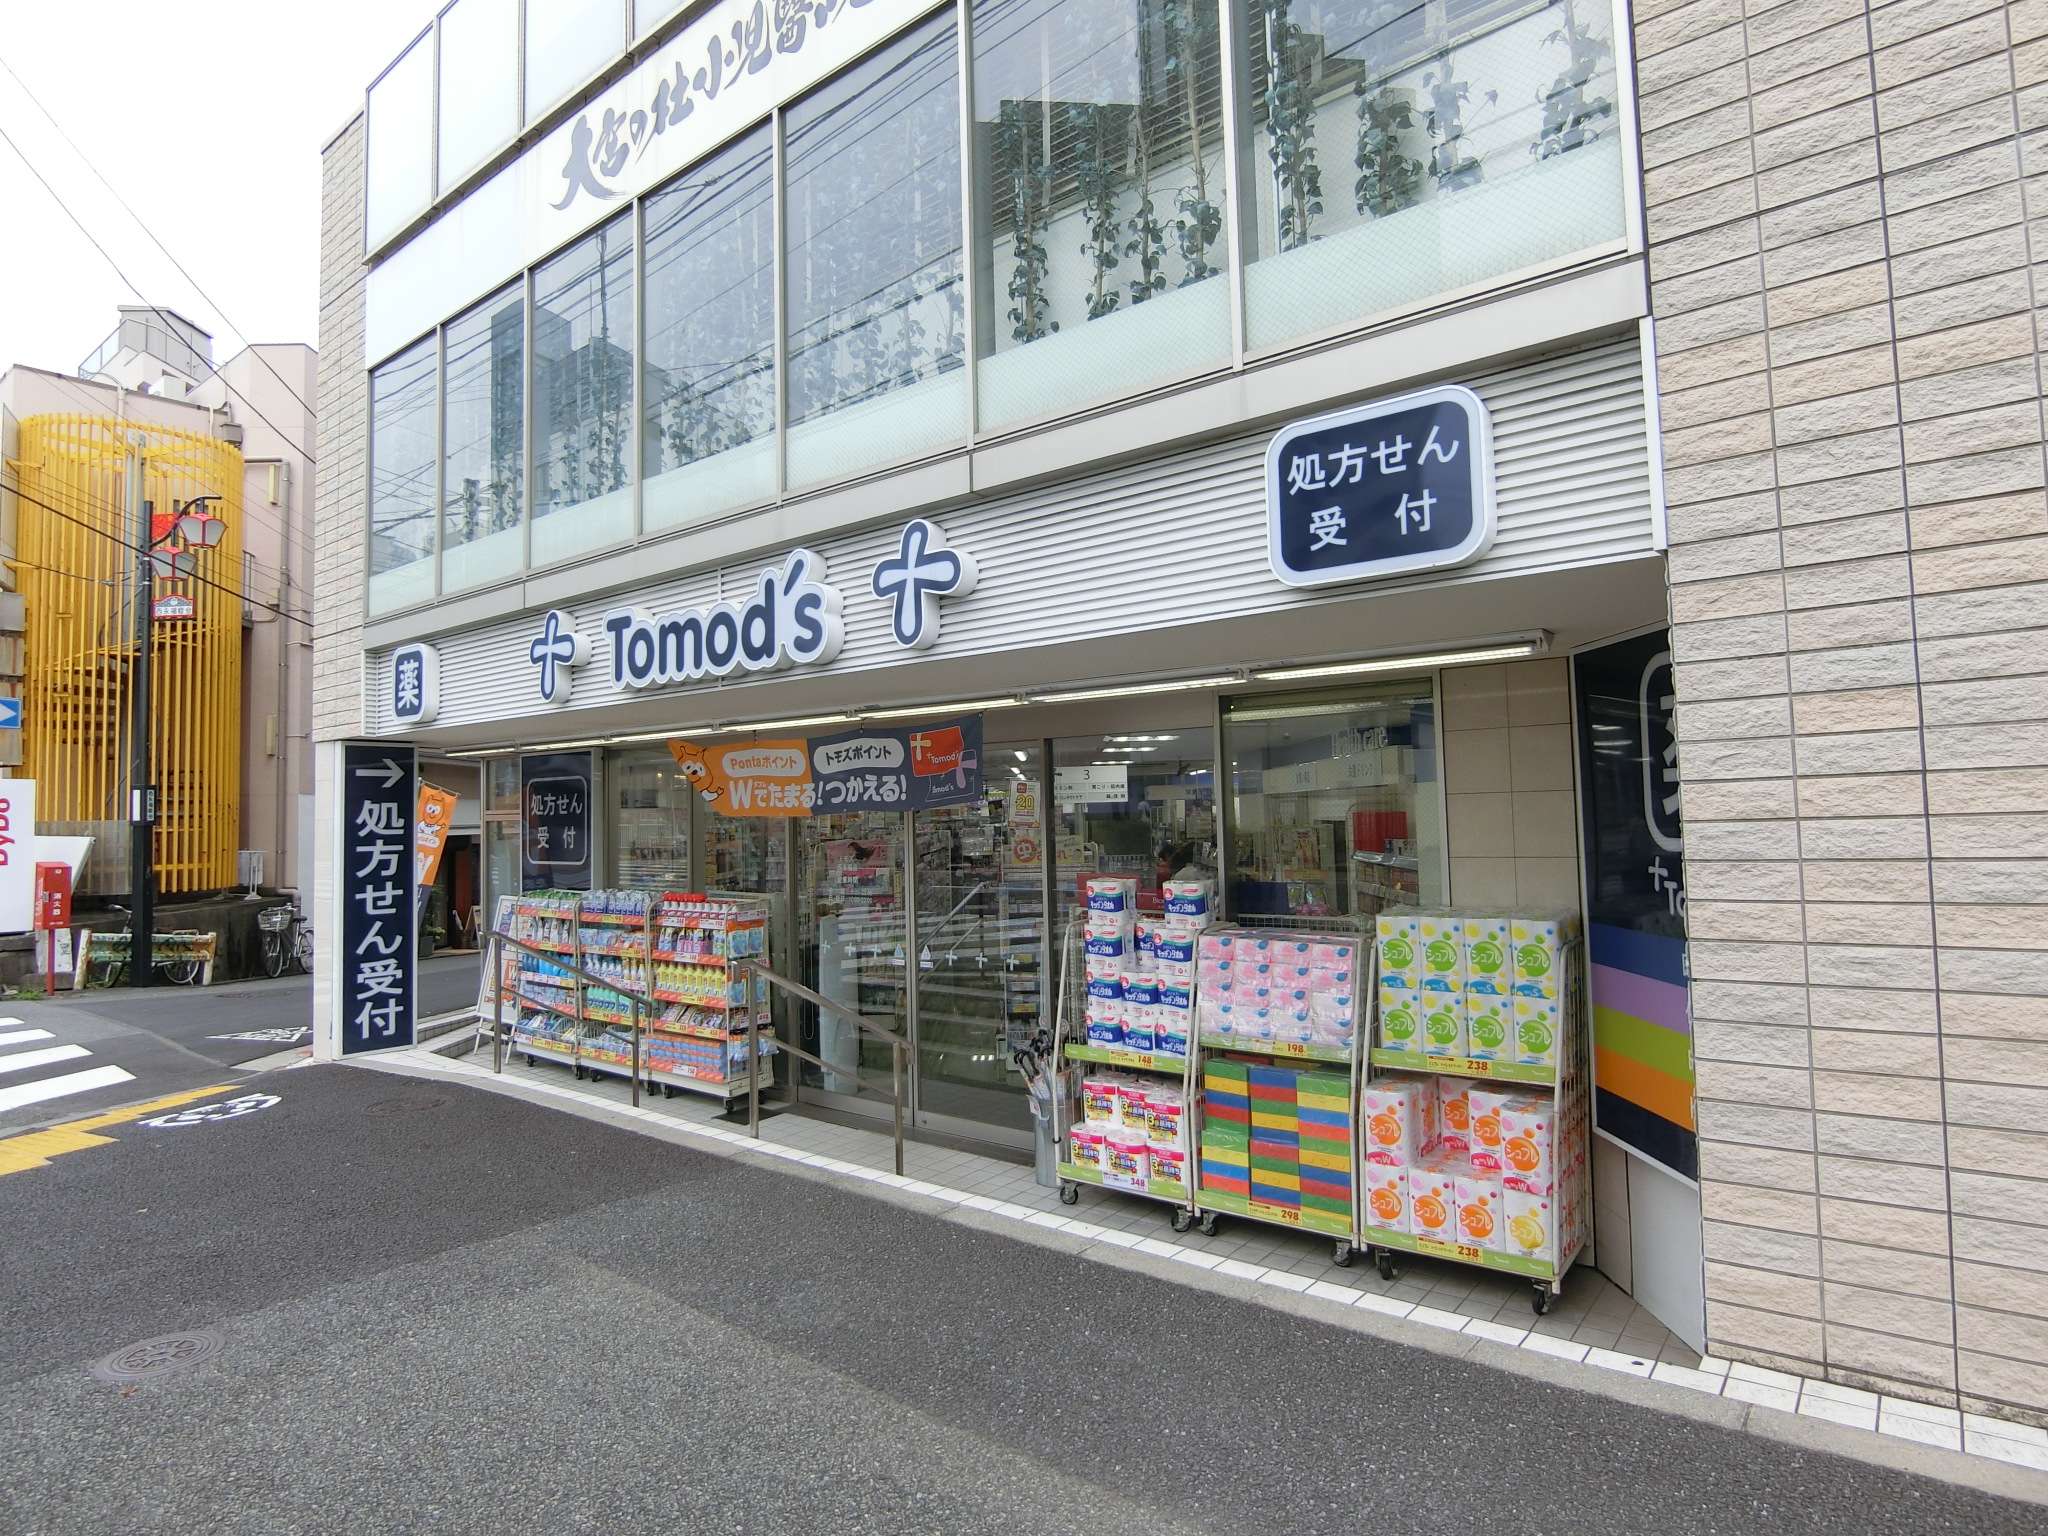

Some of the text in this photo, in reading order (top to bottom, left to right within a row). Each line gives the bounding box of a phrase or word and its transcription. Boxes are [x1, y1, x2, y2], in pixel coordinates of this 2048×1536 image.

[1287, 425, 1460, 496] 処方せん
[606, 558, 823, 682] Tomod's
[398, 661, 420, 709] 薬
[730, 754, 797, 770] Pontaポイント
[826, 745, 891, 764] トモズポイント
[1083, 769, 1090, 780] 3
[530, 793, 582, 815] 処方せん
[1016, 795, 1034, 810] 20
[355, 799, 405, 1040] 処方せん受付
[1384, 946, 1412, 960] シュフレ
[1427, 949, 1456, 962] シュフレ
[1470, 949, 1503, 964] シュフレ
[1517, 952, 1550, 968] シュフレ
[1384, 1016, 1415, 1031] シュフレ
[1426, 1020, 1458, 1035] シュフレ
[1473, 1023, 1504, 1039] シュフレ
[1520, 1028, 1552, 1044] シュフレ
[1287, 1044, 1304, 1052] 198
[1138, 1055, 1152, 1064] 148
[1467, 1060, 1488, 1070] 238
[1369, 1121, 1401, 1137] シュフレ
[1506, 1144, 1538, 1163] シュフレ
[1131, 1177, 1145, 1187] 348
[1370, 1195, 1402, 1211] シュフレ
[1281, 1210, 1299, 1220] 298
[1414, 1203, 1446, 1220] シュフレ
[1460, 1212, 1493, 1229] シュフレ
[1510, 1223, 1544, 1239] シュフレ
[1457, 1245, 1479, 1257] 238
